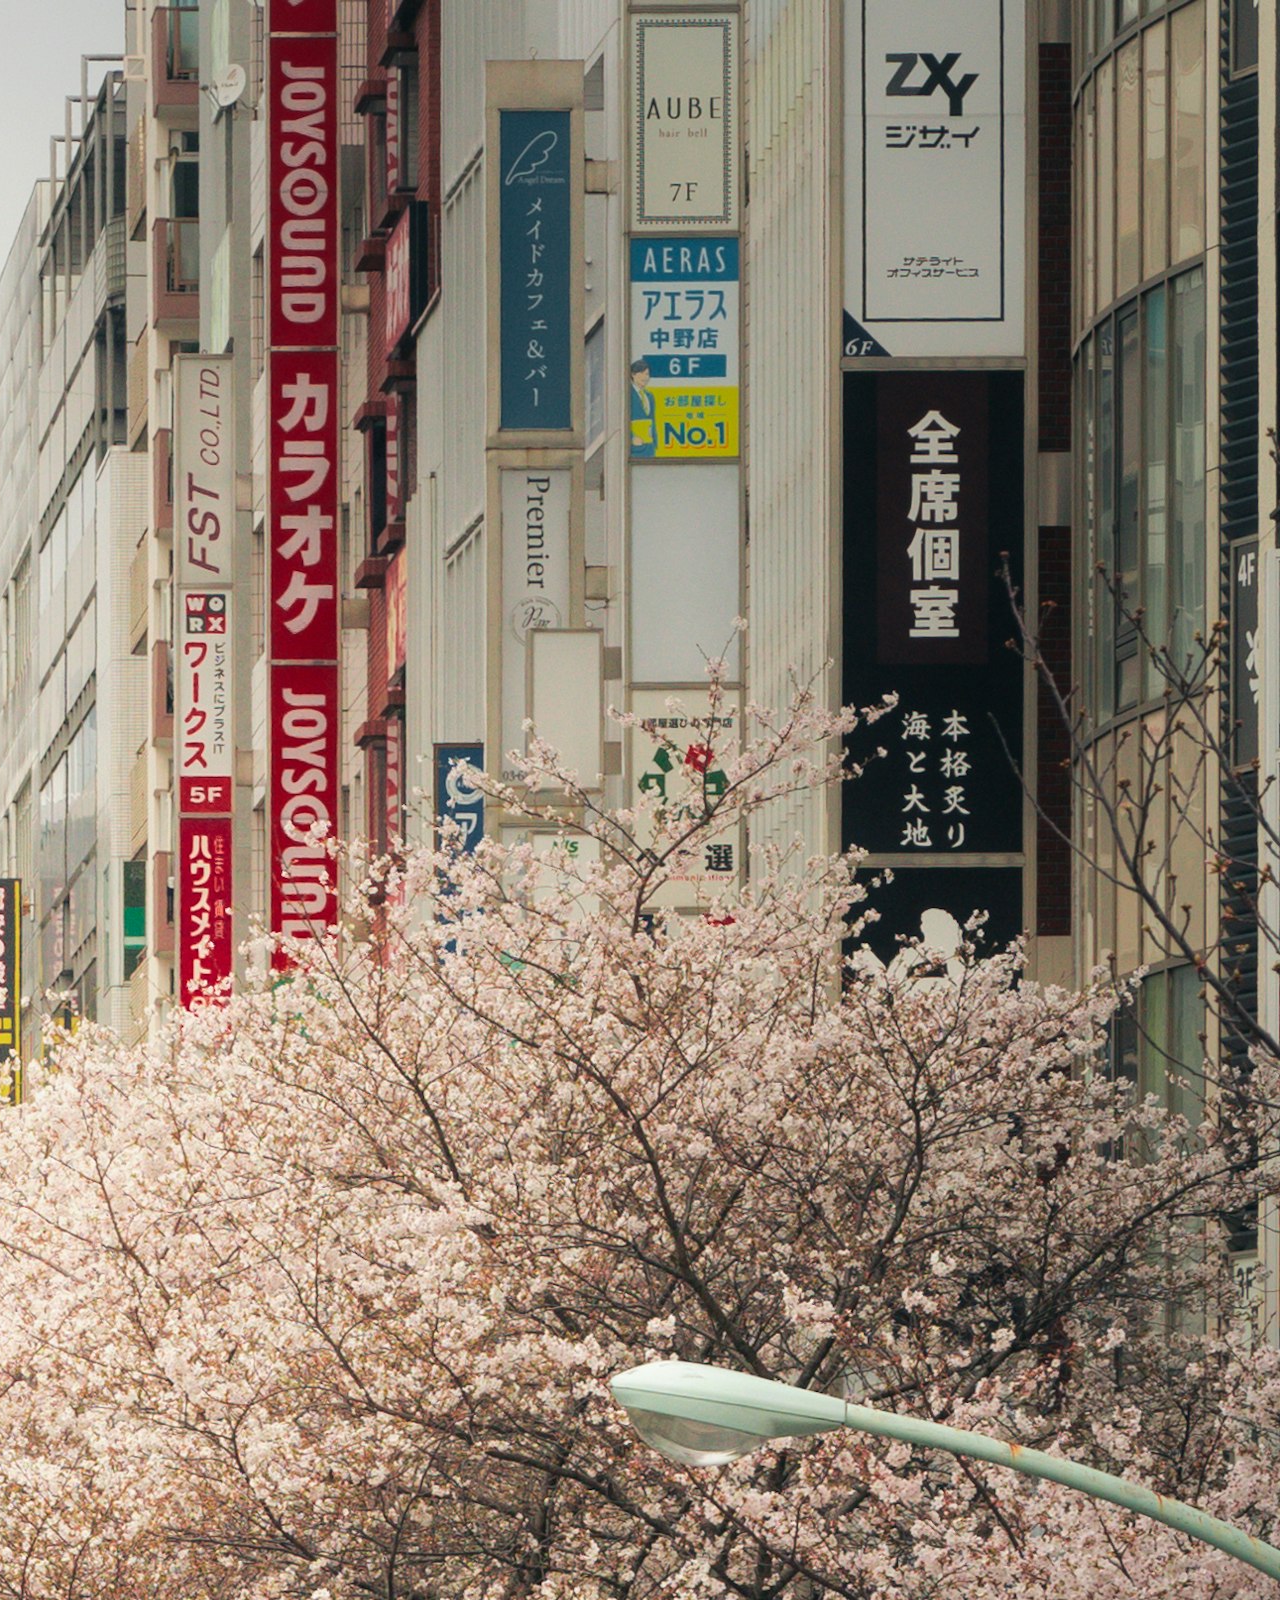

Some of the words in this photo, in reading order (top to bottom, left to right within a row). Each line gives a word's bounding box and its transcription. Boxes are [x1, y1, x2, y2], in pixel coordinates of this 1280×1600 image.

[885, 53, 979, 116] ZXY
[646, 97, 722, 120] AUBE
[658, 128, 683, 139] hair
[885, 126, 980, 149] ジザイ
[279, 61, 328, 325] JOYSOUND
[669, 183, 699, 202] 7F
[643, 246, 726, 273] AERAS
[641, 289, 728, 321] アエラス
[648, 328, 719, 349] 中野店
[845, 338, 874, 356] 6F
[669, 357, 700, 376] 6F
[663, 422, 728, 448] No.1
[277, 373, 334, 635] カラオケ
[188, 473, 221, 574] FST
[526, 476, 551, 588] Premier
[906, 410, 961, 639] 全席個室
[1237, 553, 1256, 587] 4F
[184, 641, 208, 769] ワークス
[189, 786, 224, 804] 5F
[900, 710, 932, 848] 海と大地
[941, 709, 971, 848] 本格炙り
[189, 834, 213, 985] ハウスメイト
